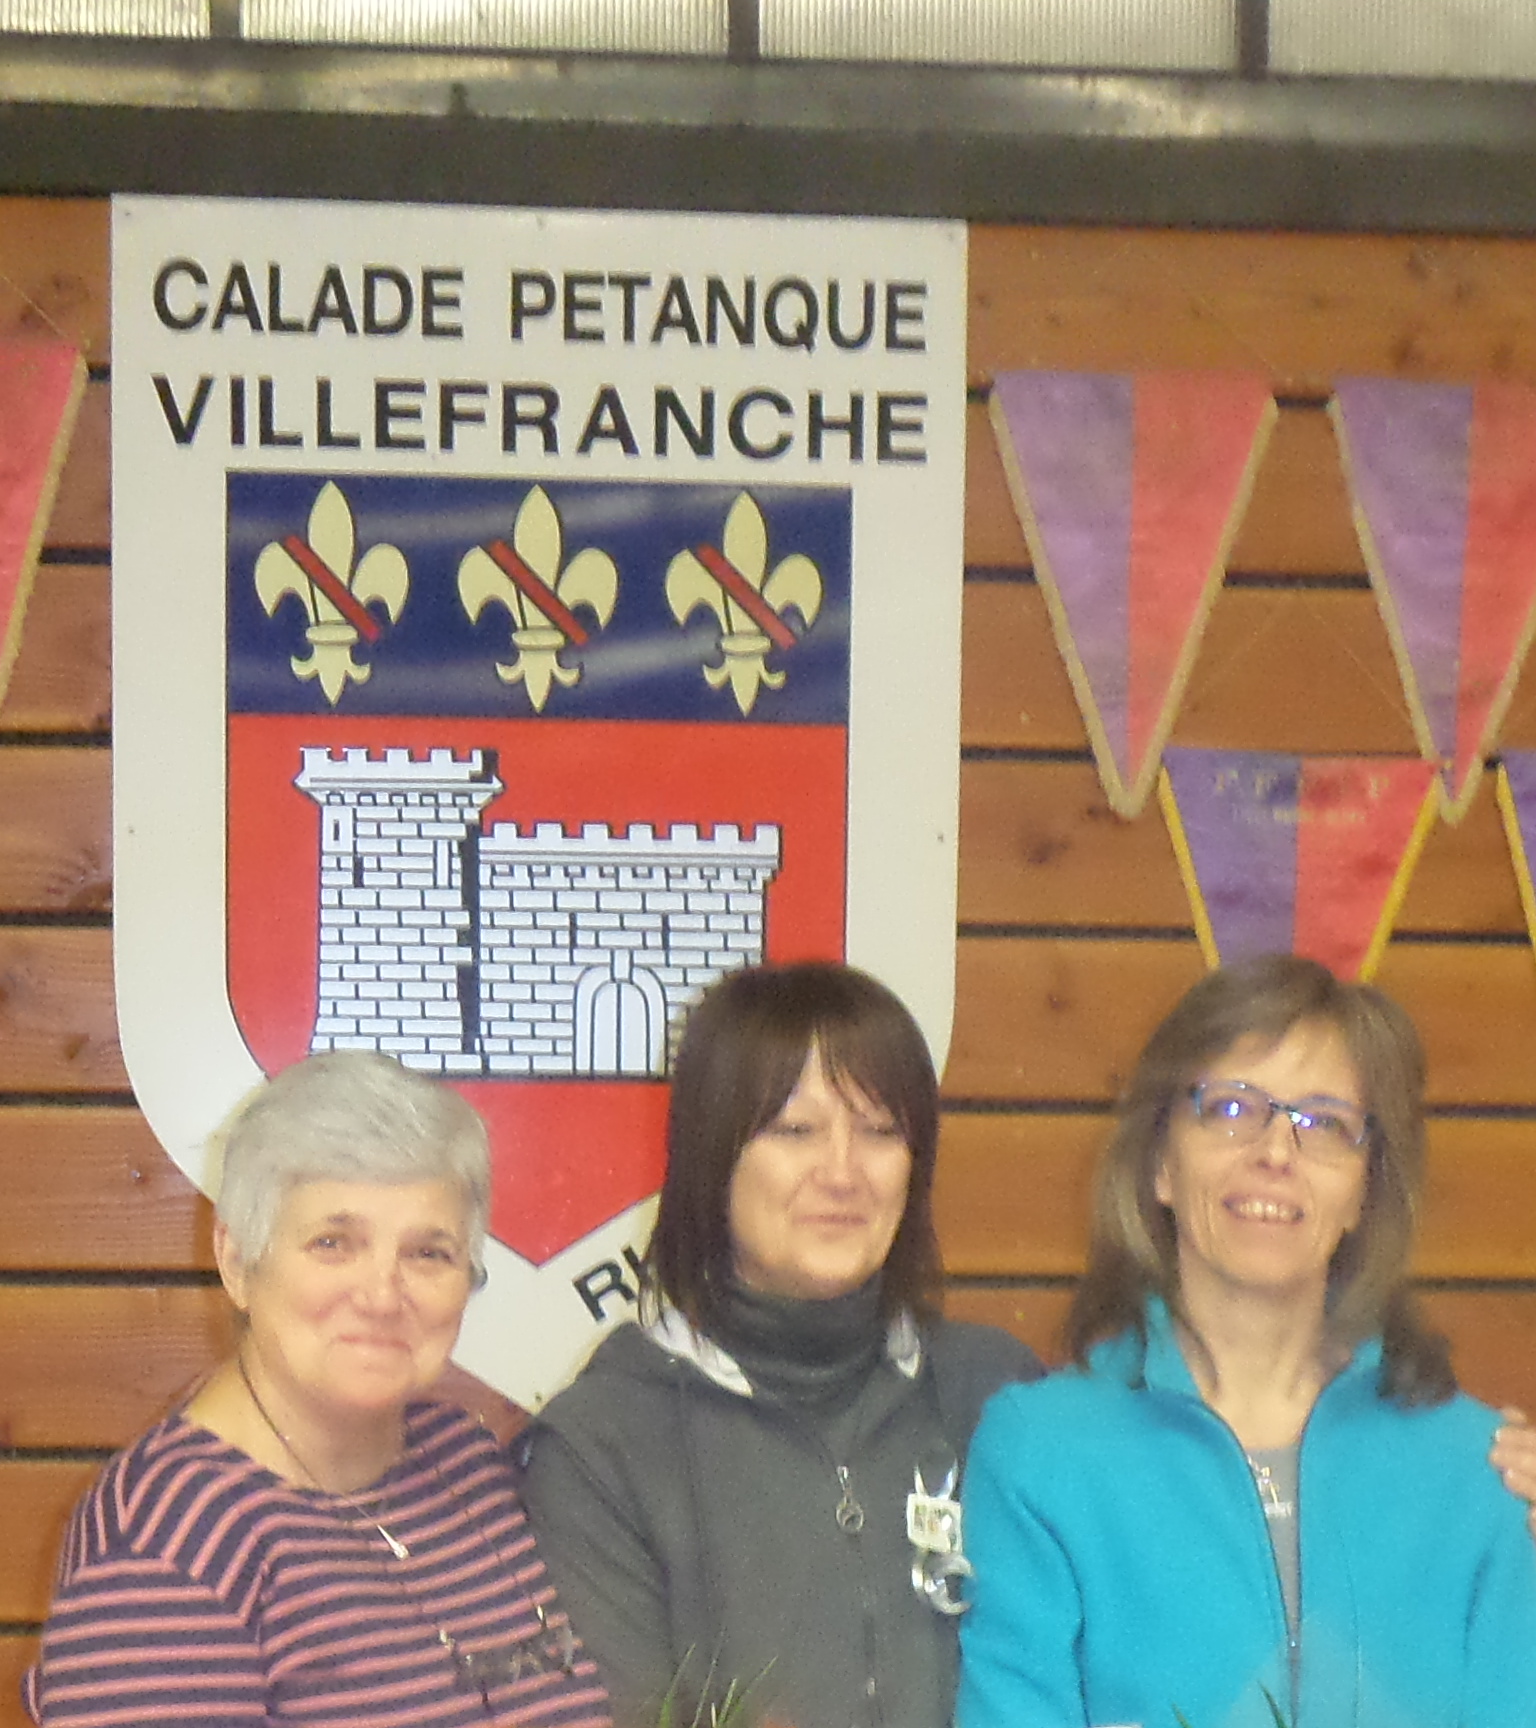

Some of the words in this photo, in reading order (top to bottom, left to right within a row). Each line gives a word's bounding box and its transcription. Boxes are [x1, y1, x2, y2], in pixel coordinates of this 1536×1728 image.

[152, 259, 464, 338] CALADE
[510, 269, 927, 353] PETANQUE
[152, 374, 928, 463] VILLEFRANCHE
